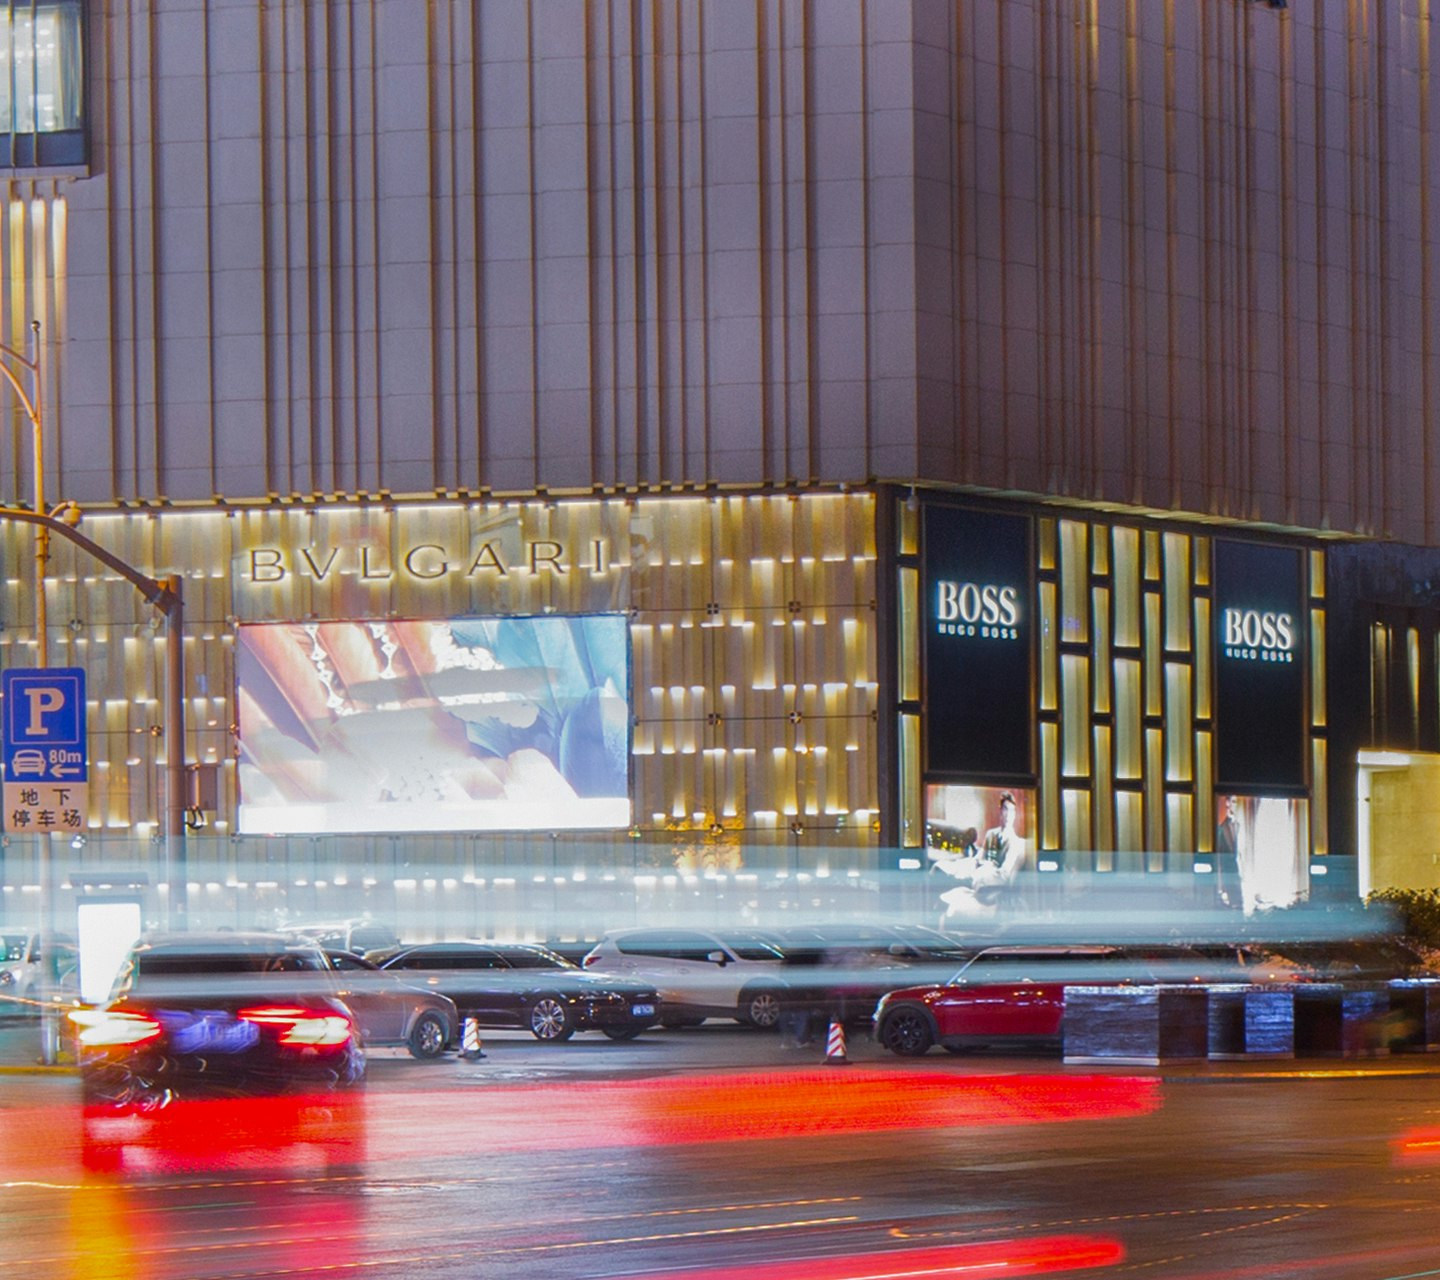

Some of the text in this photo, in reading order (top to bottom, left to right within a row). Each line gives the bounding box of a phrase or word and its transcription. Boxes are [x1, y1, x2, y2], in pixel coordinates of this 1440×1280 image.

[250, 540, 605, 583] BVLGARI
[938, 581, 1017, 626] BOSS
[938, 623, 1018, 640] HUGO BOSS
[1225, 608, 1292, 650] BOSS
[1226, 647, 1293, 662] HUGO BOSS
[24, 688, 65, 735] P
[49, 749, 82, 763] 80m
[20, 788, 71, 806] 地下
[12, 809, 82, 828] 停车场
